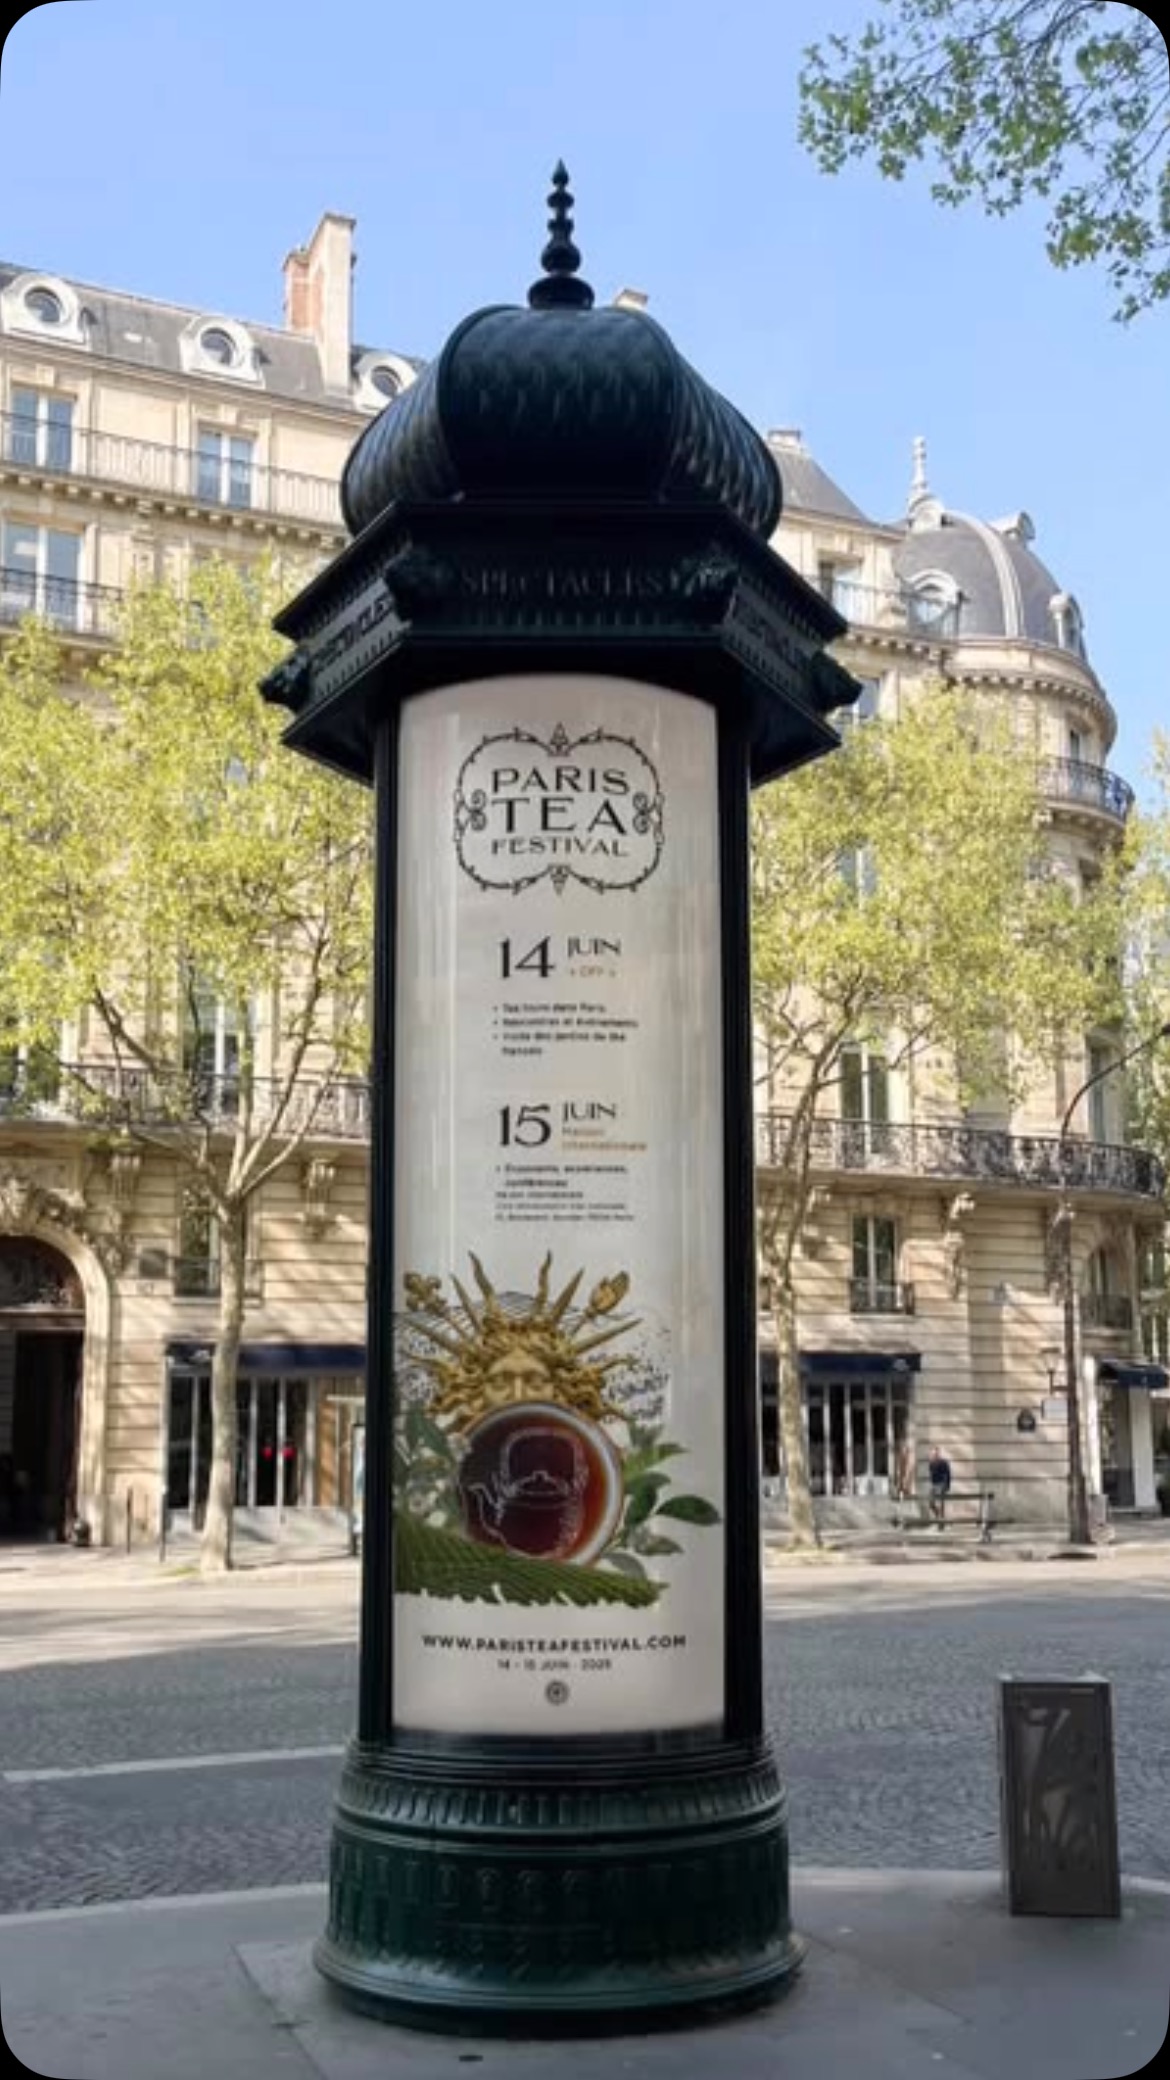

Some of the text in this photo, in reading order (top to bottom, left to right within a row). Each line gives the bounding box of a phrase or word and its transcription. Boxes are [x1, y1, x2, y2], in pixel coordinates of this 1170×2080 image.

[491, 766, 630, 796] PARIS
[491, 797, 627, 835] TEA
[491, 836, 629, 857] FESTIVAL
[500, 935, 621, 979] 14 JUIN
[499, 1102, 617, 1148] 15 JUIN
[421, 1634, 687, 1652] WWW.PARISTEAFESTIVAL.COM
